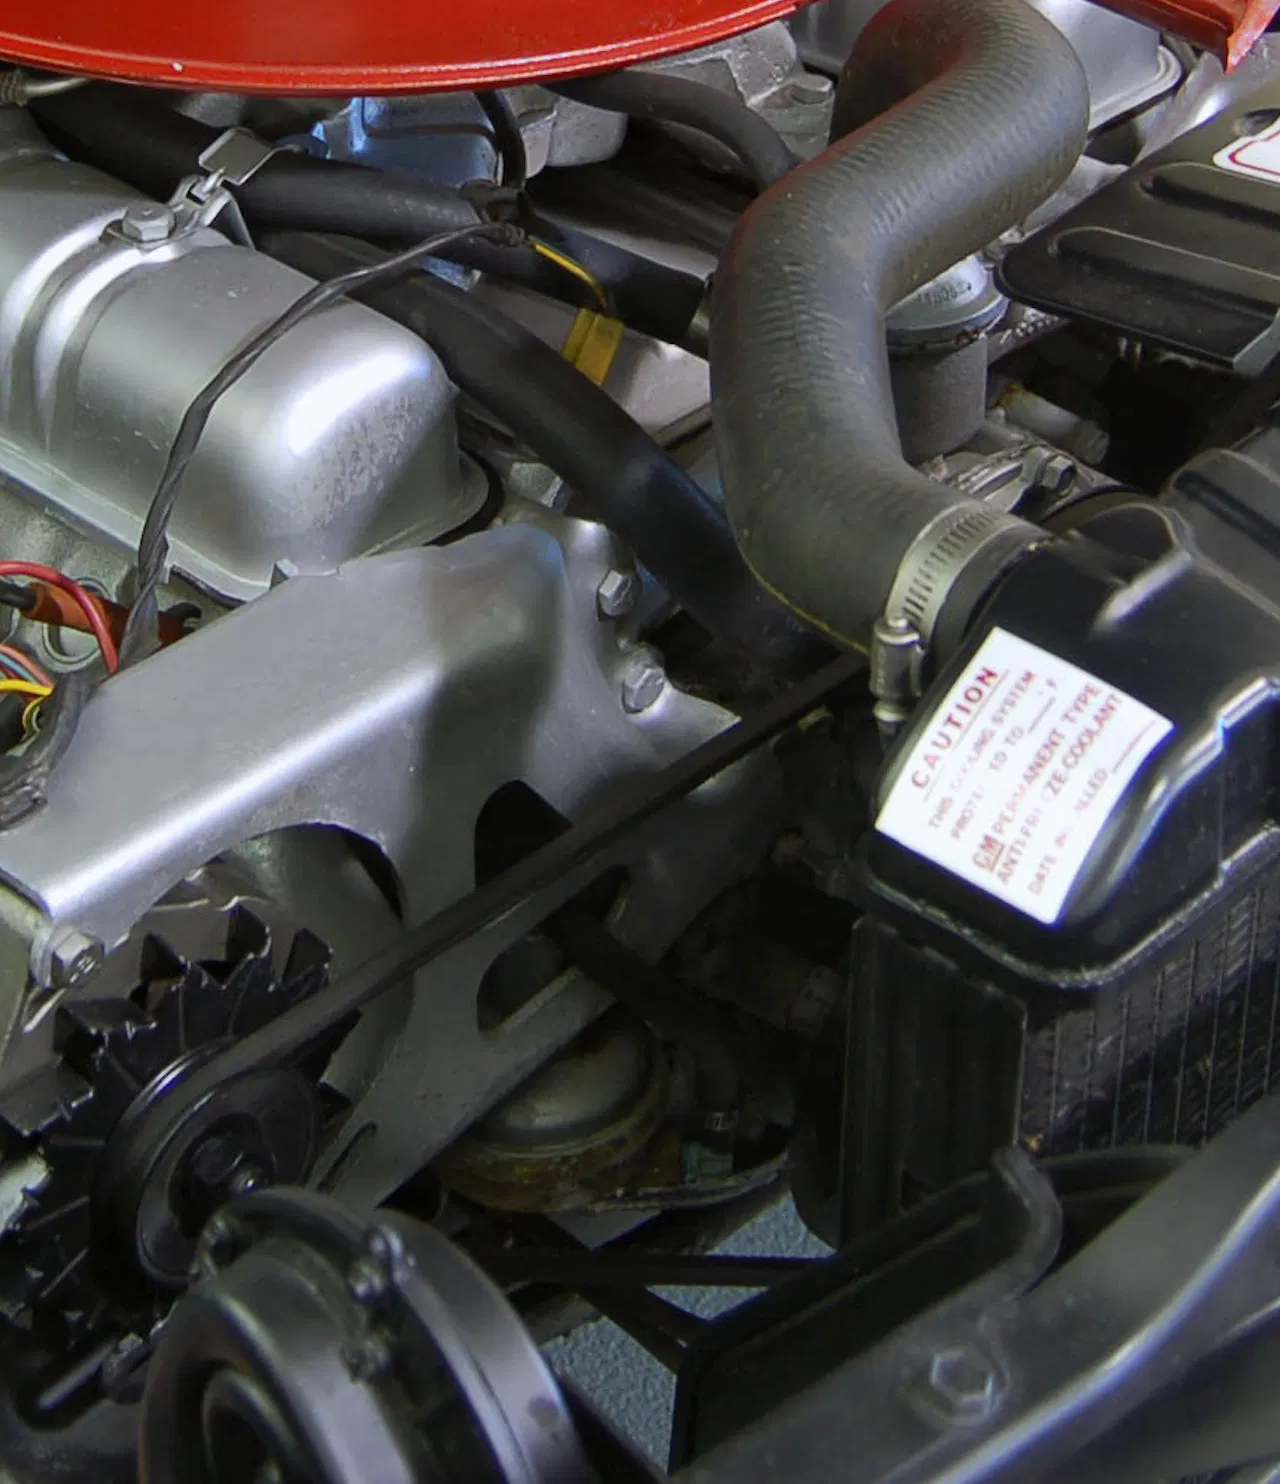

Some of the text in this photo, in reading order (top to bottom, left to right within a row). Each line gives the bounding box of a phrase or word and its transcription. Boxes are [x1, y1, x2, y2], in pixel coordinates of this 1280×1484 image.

[910, 666, 999, 790] CAUTION
[928, 796, 954, 830] THIS
[991, 669, 1036, 727] SYSTEM
[950, 750, 1009, 840] PROTEED
[1003, 726, 1025, 748] TO
[971, 834, 1001, 871] GM
[1061, 682, 1101, 725] TYPE
